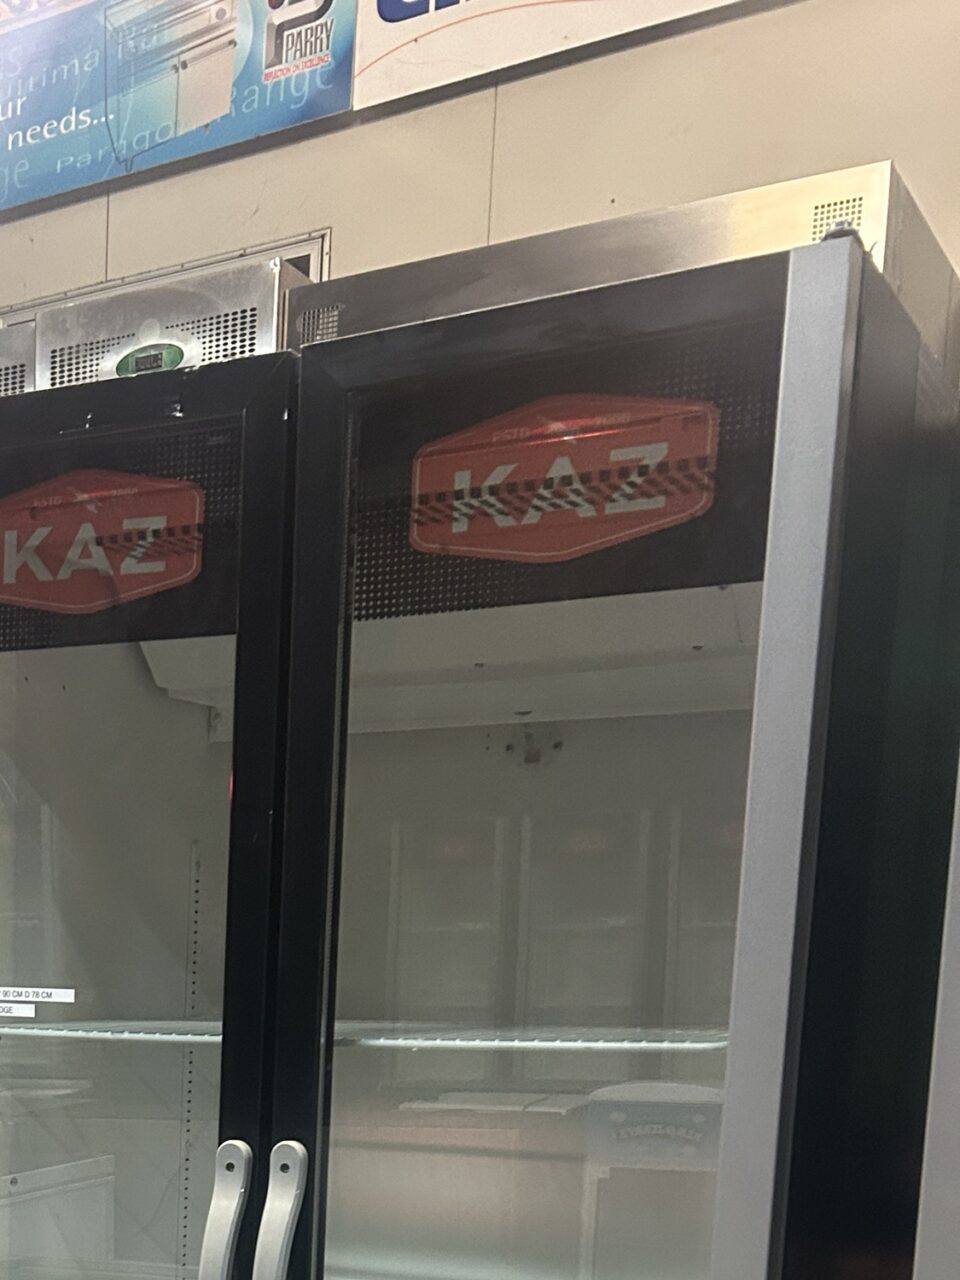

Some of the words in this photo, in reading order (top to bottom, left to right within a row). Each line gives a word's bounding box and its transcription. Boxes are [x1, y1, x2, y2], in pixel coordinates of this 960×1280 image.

[284, 18, 334, 63] PARRY
[8, 106, 114, 150] needs...
[451, 442, 669, 533] KAZ
[3, 516, 167, 584] KAZ
[12, 990, 23, 998] CM
